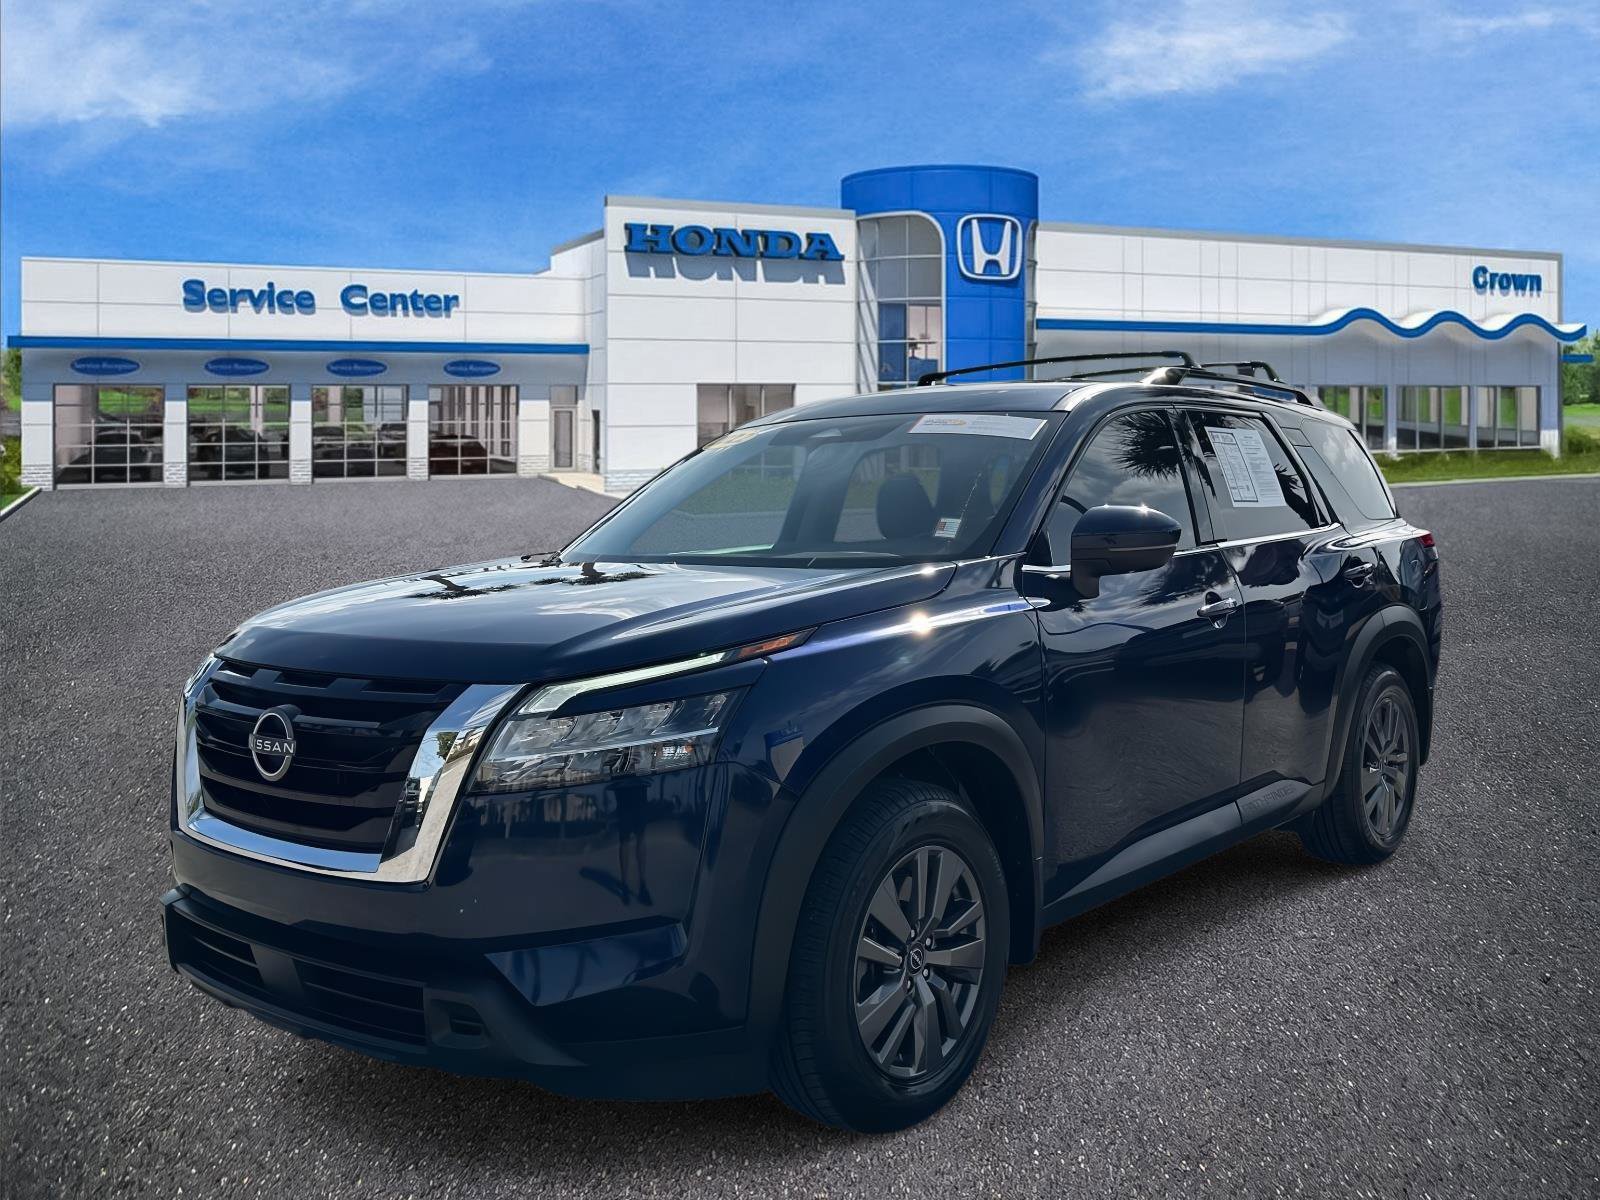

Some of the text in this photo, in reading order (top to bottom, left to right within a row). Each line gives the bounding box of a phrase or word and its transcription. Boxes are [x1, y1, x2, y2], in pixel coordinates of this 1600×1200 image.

[624, 223, 845, 261] HONDA
[1472, 265, 1542, 291] Crown
[182, 279, 460, 312] Service Center
